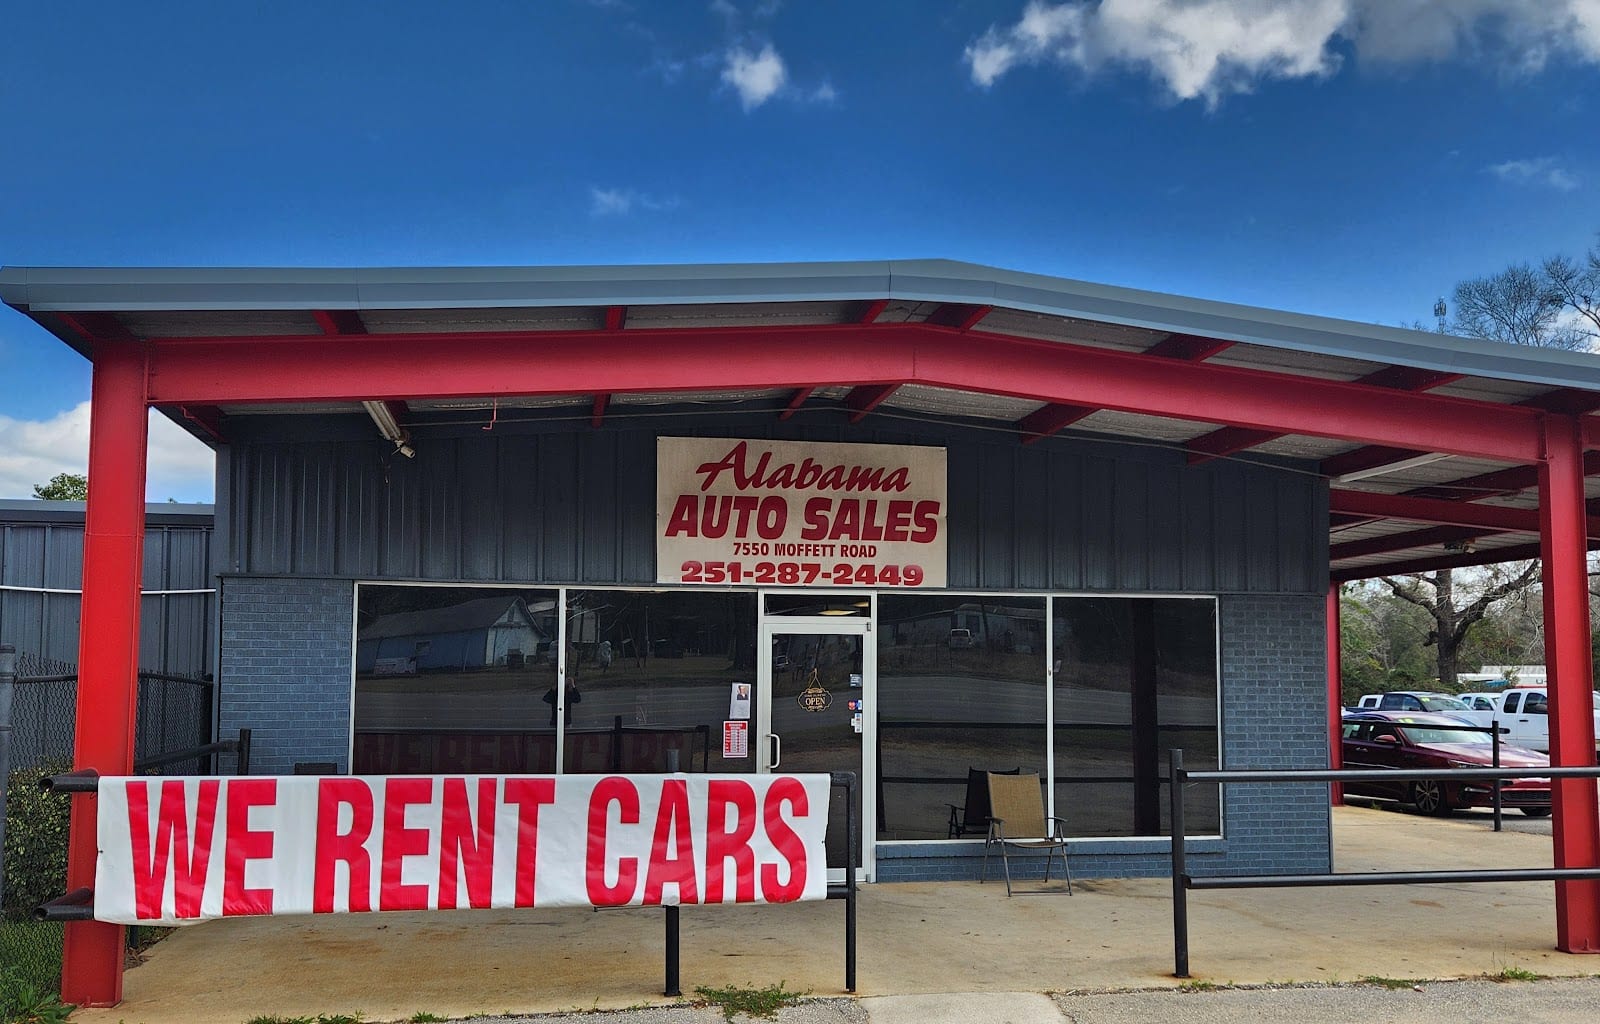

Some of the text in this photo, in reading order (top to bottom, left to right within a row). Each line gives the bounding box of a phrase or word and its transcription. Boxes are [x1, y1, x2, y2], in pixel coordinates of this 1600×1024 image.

[696, 441, 911, 492] Alabama
[664, 495, 941, 543] AUTO SALES
[733, 542, 877, 558] 7550 MOFFETT ROAD
[681, 560, 924, 586] 251-287-2449
[805, 697, 826, 706] OPEN
[126, 776, 809, 920] WE RENT CARS
